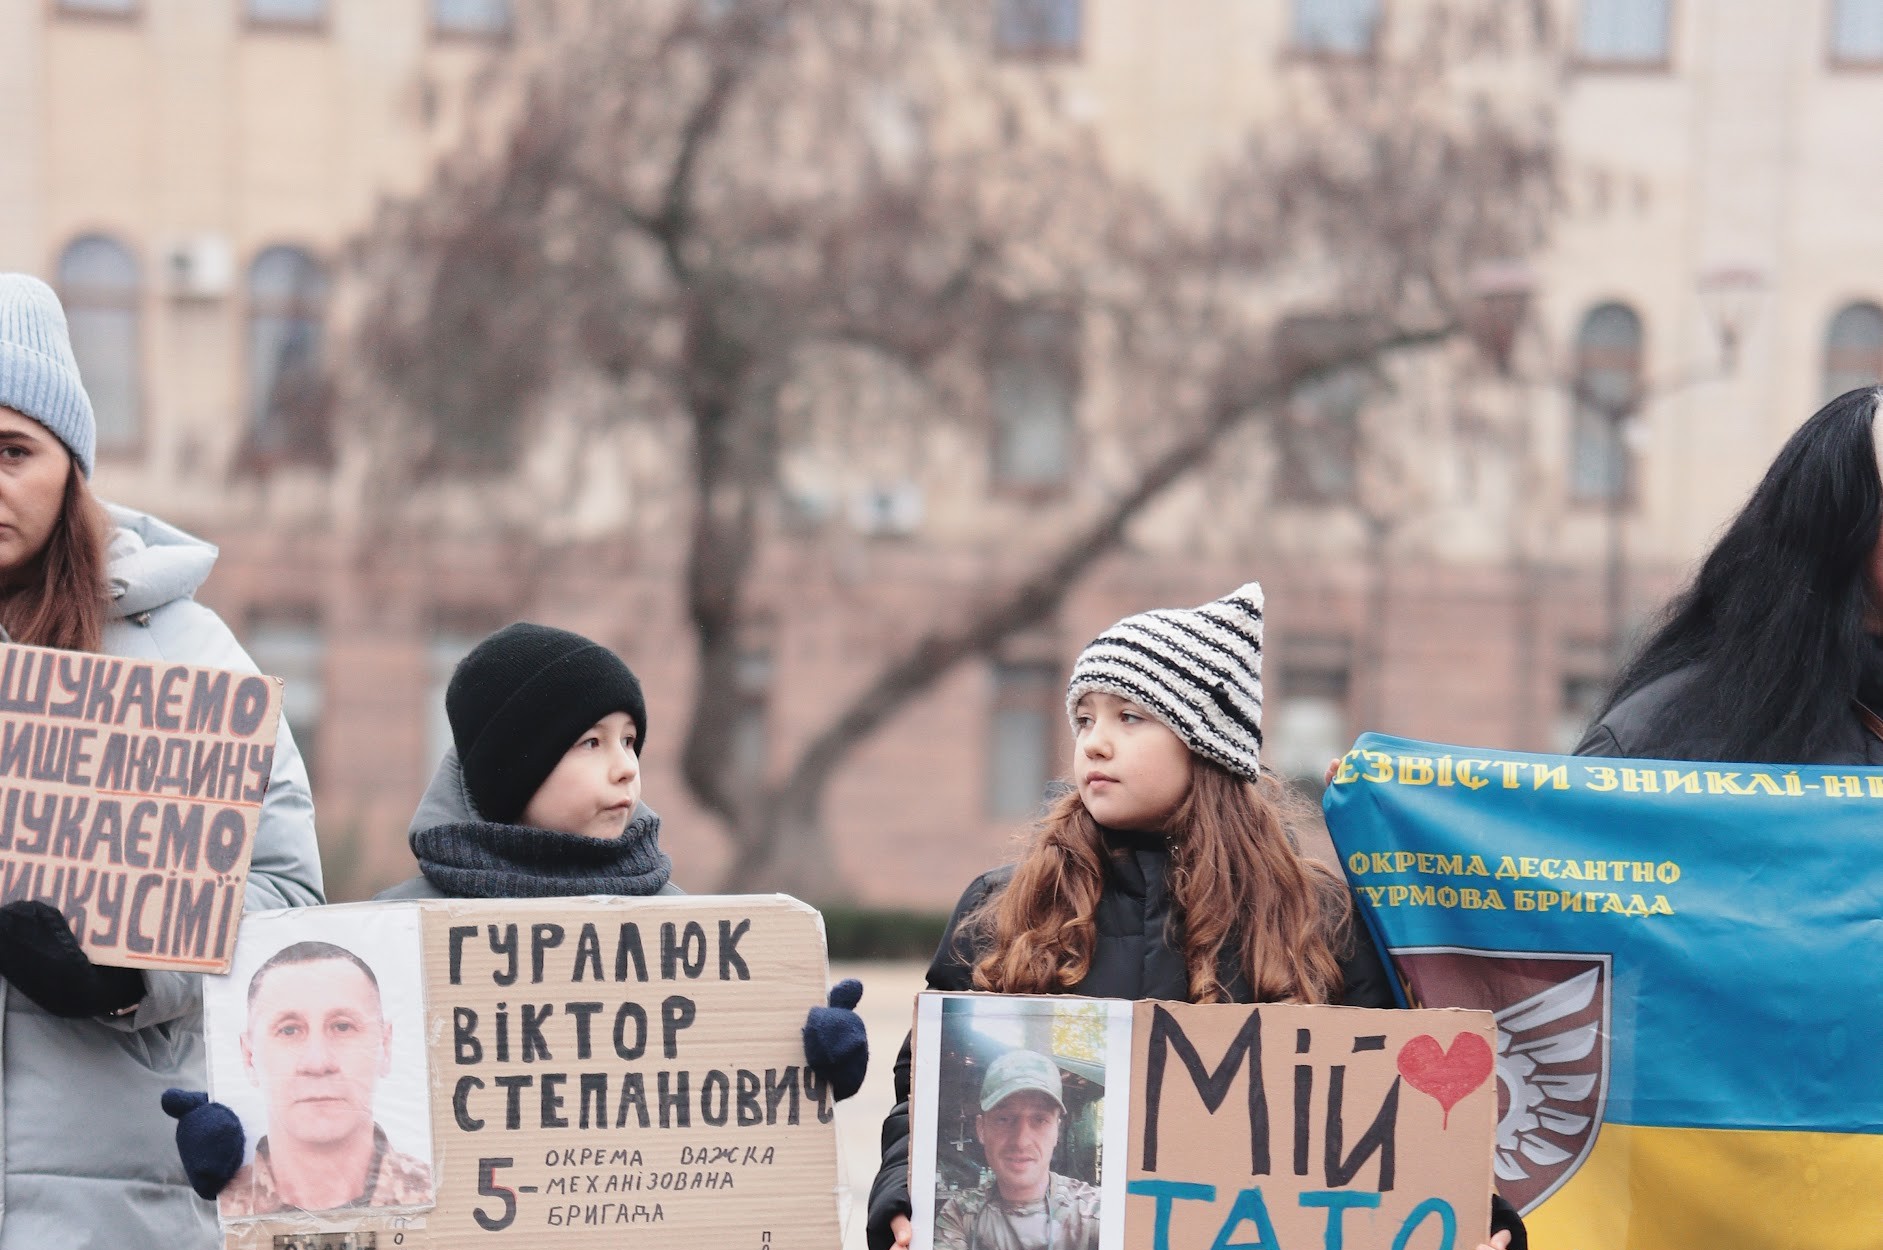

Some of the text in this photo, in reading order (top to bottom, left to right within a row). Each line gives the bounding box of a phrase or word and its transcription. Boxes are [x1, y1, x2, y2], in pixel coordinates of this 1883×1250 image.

[0, 648, 270, 738] ШУКАЄМО
[96, 732, 276, 803] ЛЮДИНУ
[1348, 851, 1681, 885] ОКРЕМА ДЕСАНТНО
[1355, 884, 1674, 916] УРМОВА БРИГАДА
[449, 918, 751, 987] ГУРАЛЮК
[453, 995, 697, 1065] ВІКТОР
[452, 1066, 834, 1132] СТЕПАНОВИЧ
[545, 1145, 775, 1167] ОКРЕМА ВАЖКА
[545, 1171, 735, 1196] МЕХАНІЗОВАНА
[547, 1203, 665, 1227] БРИГАДА
